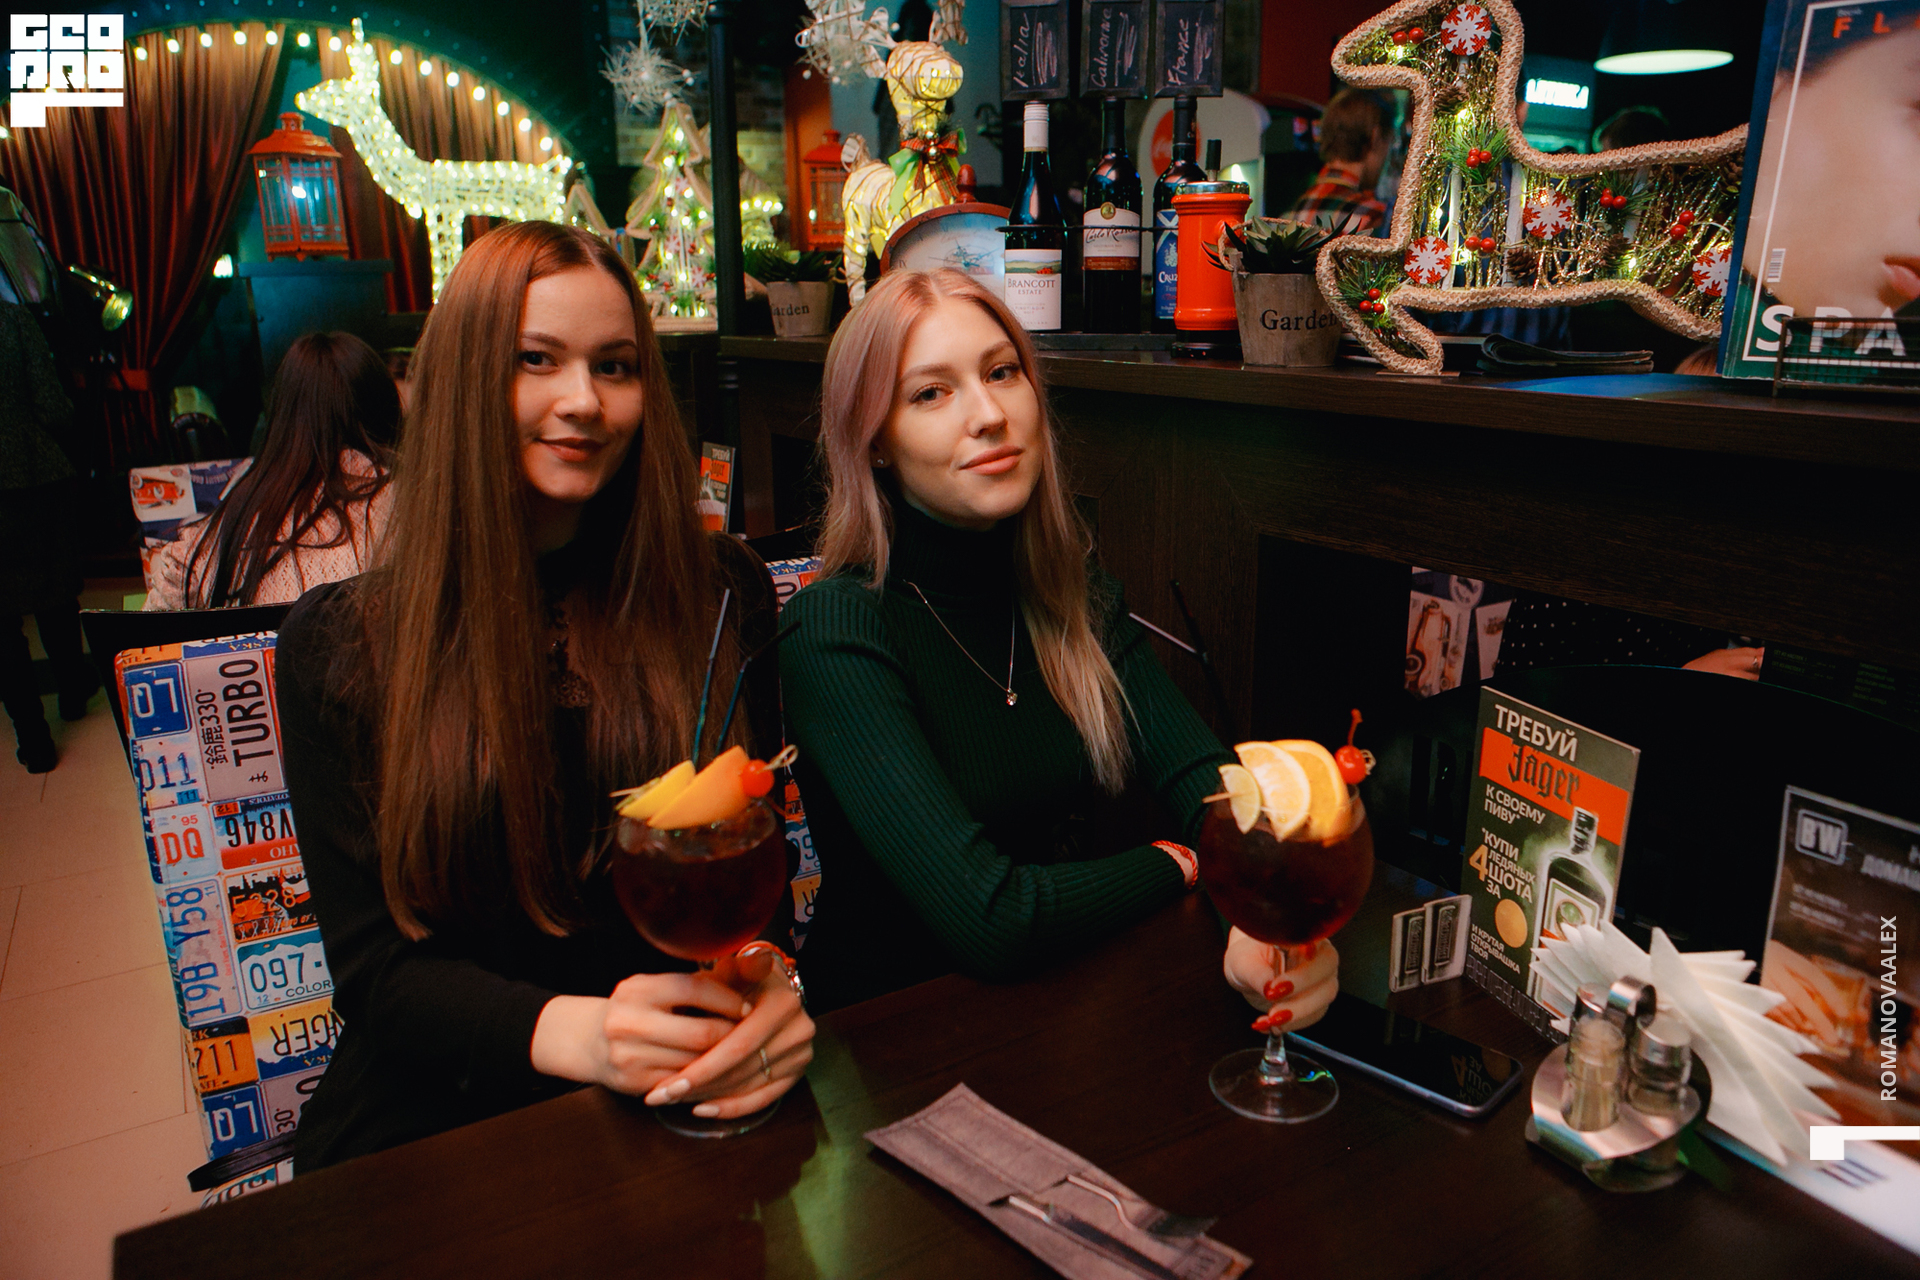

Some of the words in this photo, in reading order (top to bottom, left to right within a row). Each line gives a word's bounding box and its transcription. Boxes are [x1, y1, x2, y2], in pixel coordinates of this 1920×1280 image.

[1013, 12, 1029, 88] Italia
[1007, 278, 1056, 288] BRANCOTT
[770, 303, 810, 316] arden
[1260, 309, 1337, 331] Garden
[1755, 304, 1906, 357] SPA
[218, 659, 274, 767] TURBO
[1495, 703, 1578, 762] ТРЕБУЙ
[1507, 738, 1580, 805] Jäger
[181, 814, 198, 826] 95
[1486, 784, 1495, 799] К
[1495, 790, 1546, 825] СВОЕМУ
[1469, 844, 1489, 882] 4
[1488, 850, 1536, 885] ЛЕДЯНЫХ
[1486, 879, 1501, 899] ЗА
[1488, 863, 1533, 903] ШОТА
[1470, 941, 1489, 961] ТВОЯ
[1471, 933, 1521, 975] ОТКРЫВАШКА
[1478, 928, 1505, 953] КРУТАЯ
[285, 979, 332, 998] COLOR
